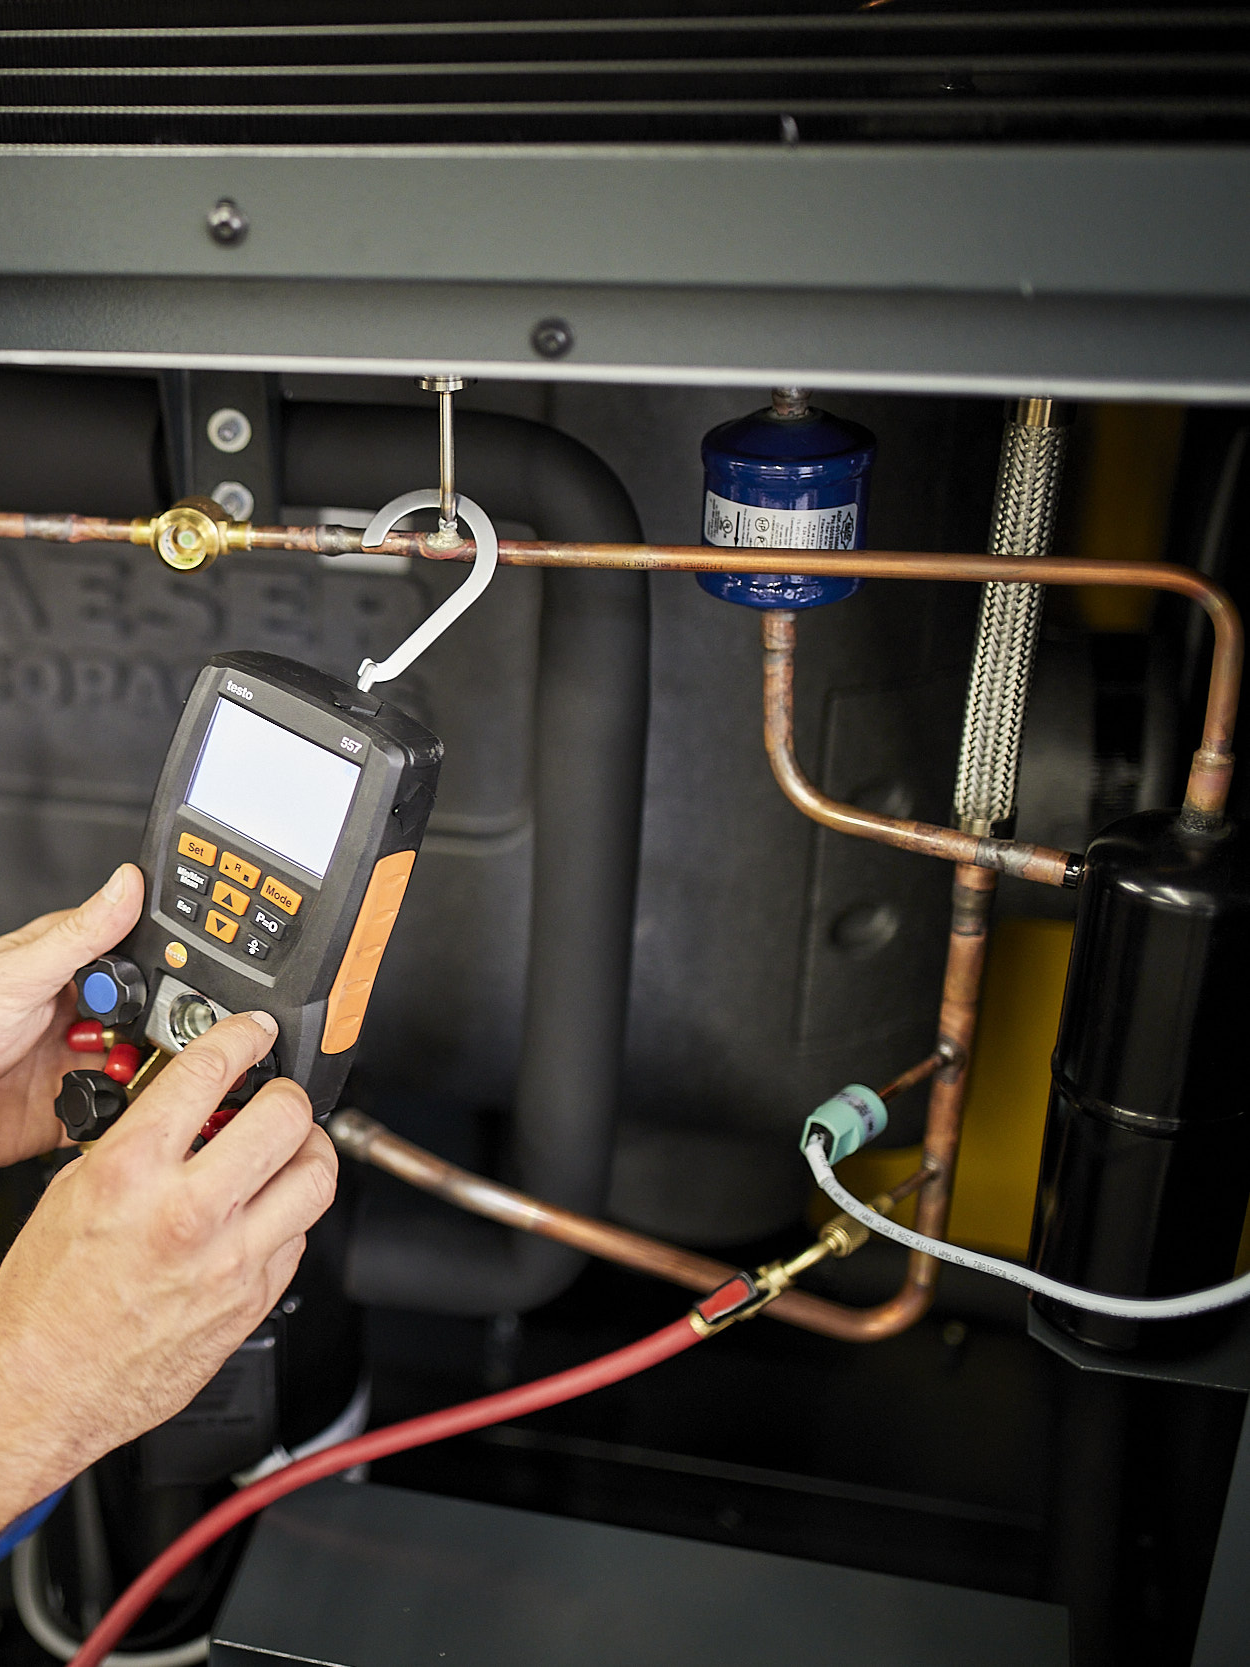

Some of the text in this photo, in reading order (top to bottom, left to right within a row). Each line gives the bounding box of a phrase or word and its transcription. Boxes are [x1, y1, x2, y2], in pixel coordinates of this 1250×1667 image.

[226, 680, 253, 700] testo
[340, 736, 363, 753] 557
[188, 842, 204, 856] Set
[234, 863, 242, 872] R
[265, 885, 292, 908] Mode
[176, 900, 192, 914] Esc
